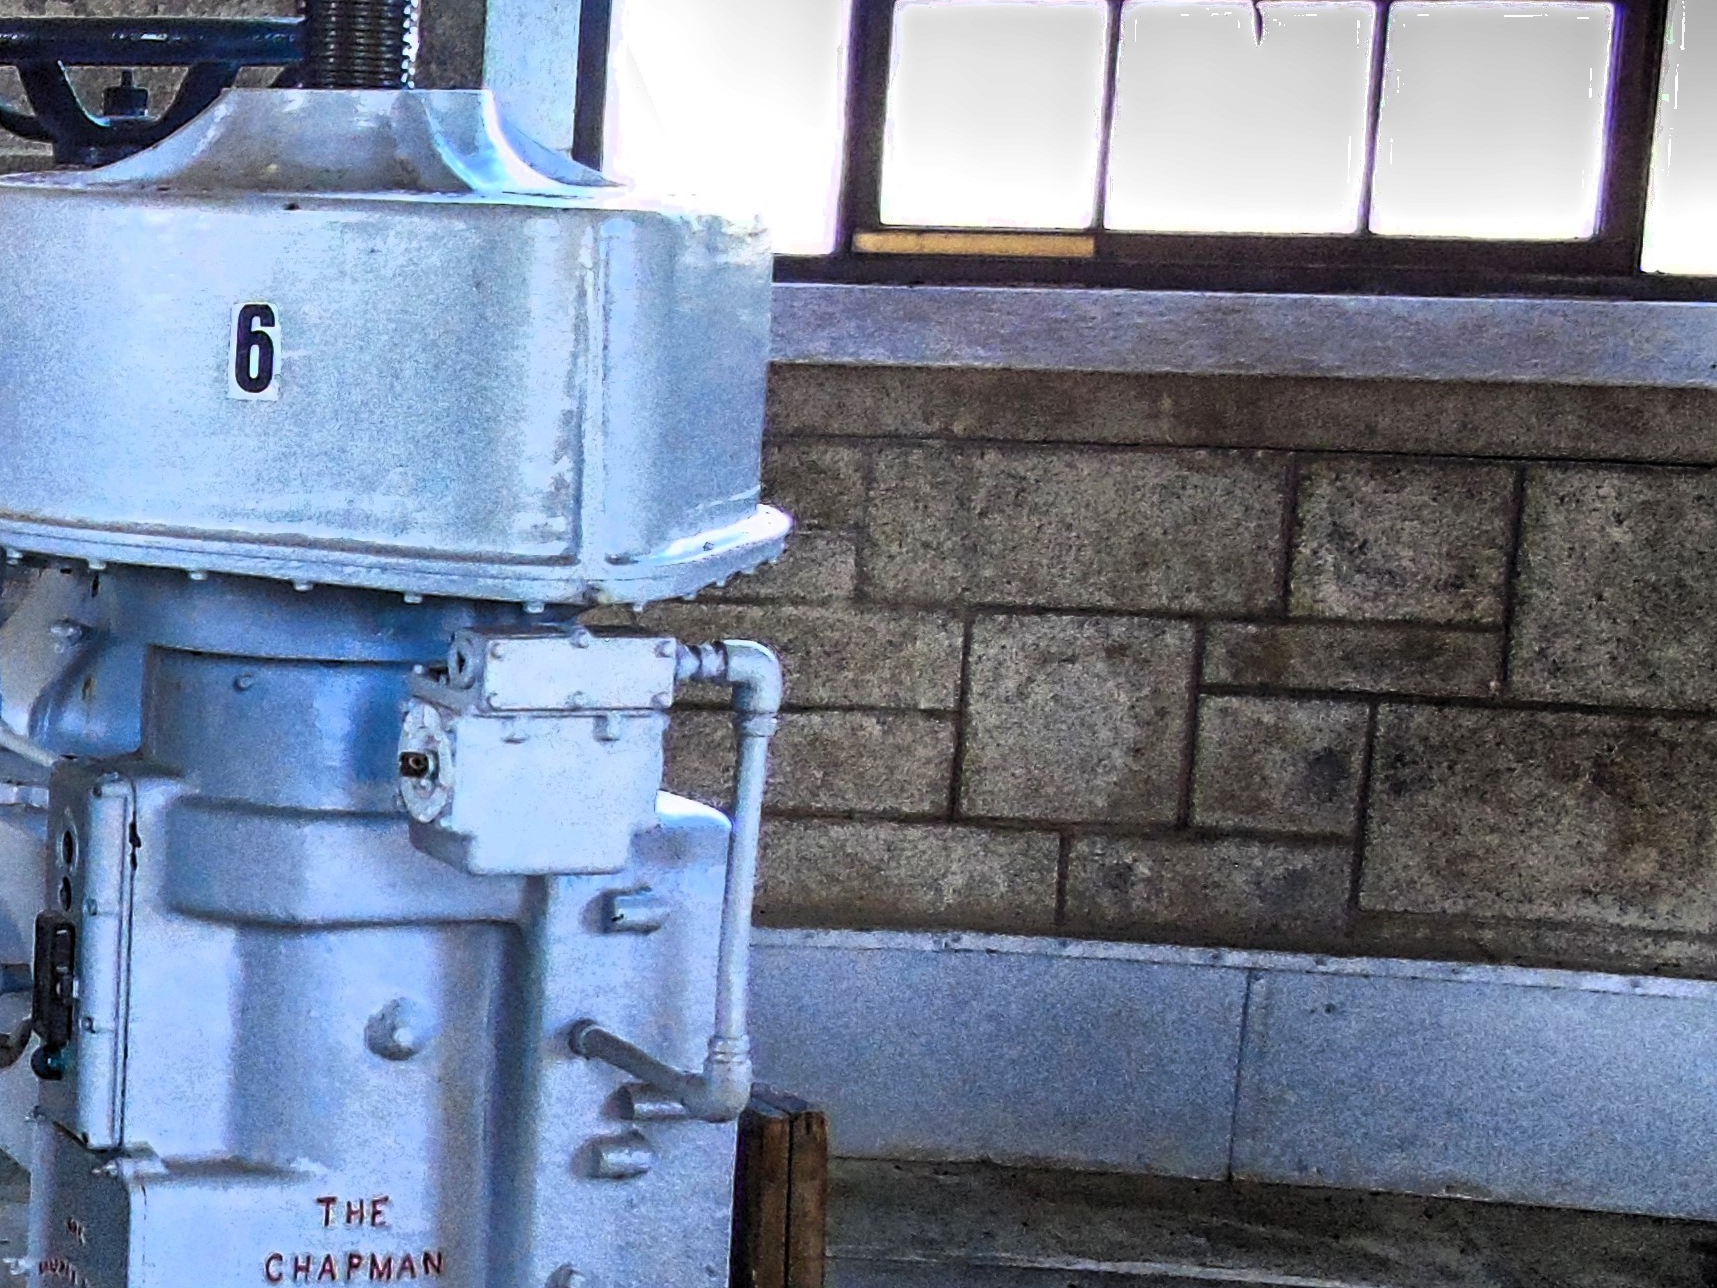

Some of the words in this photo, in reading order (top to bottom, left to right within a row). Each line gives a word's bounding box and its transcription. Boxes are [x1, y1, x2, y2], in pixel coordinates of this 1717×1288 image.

[235, 304, 275, 393] 6
[316, 1195, 390, 1227] THE
[264, 1250, 444, 1283] CHAPMAN
